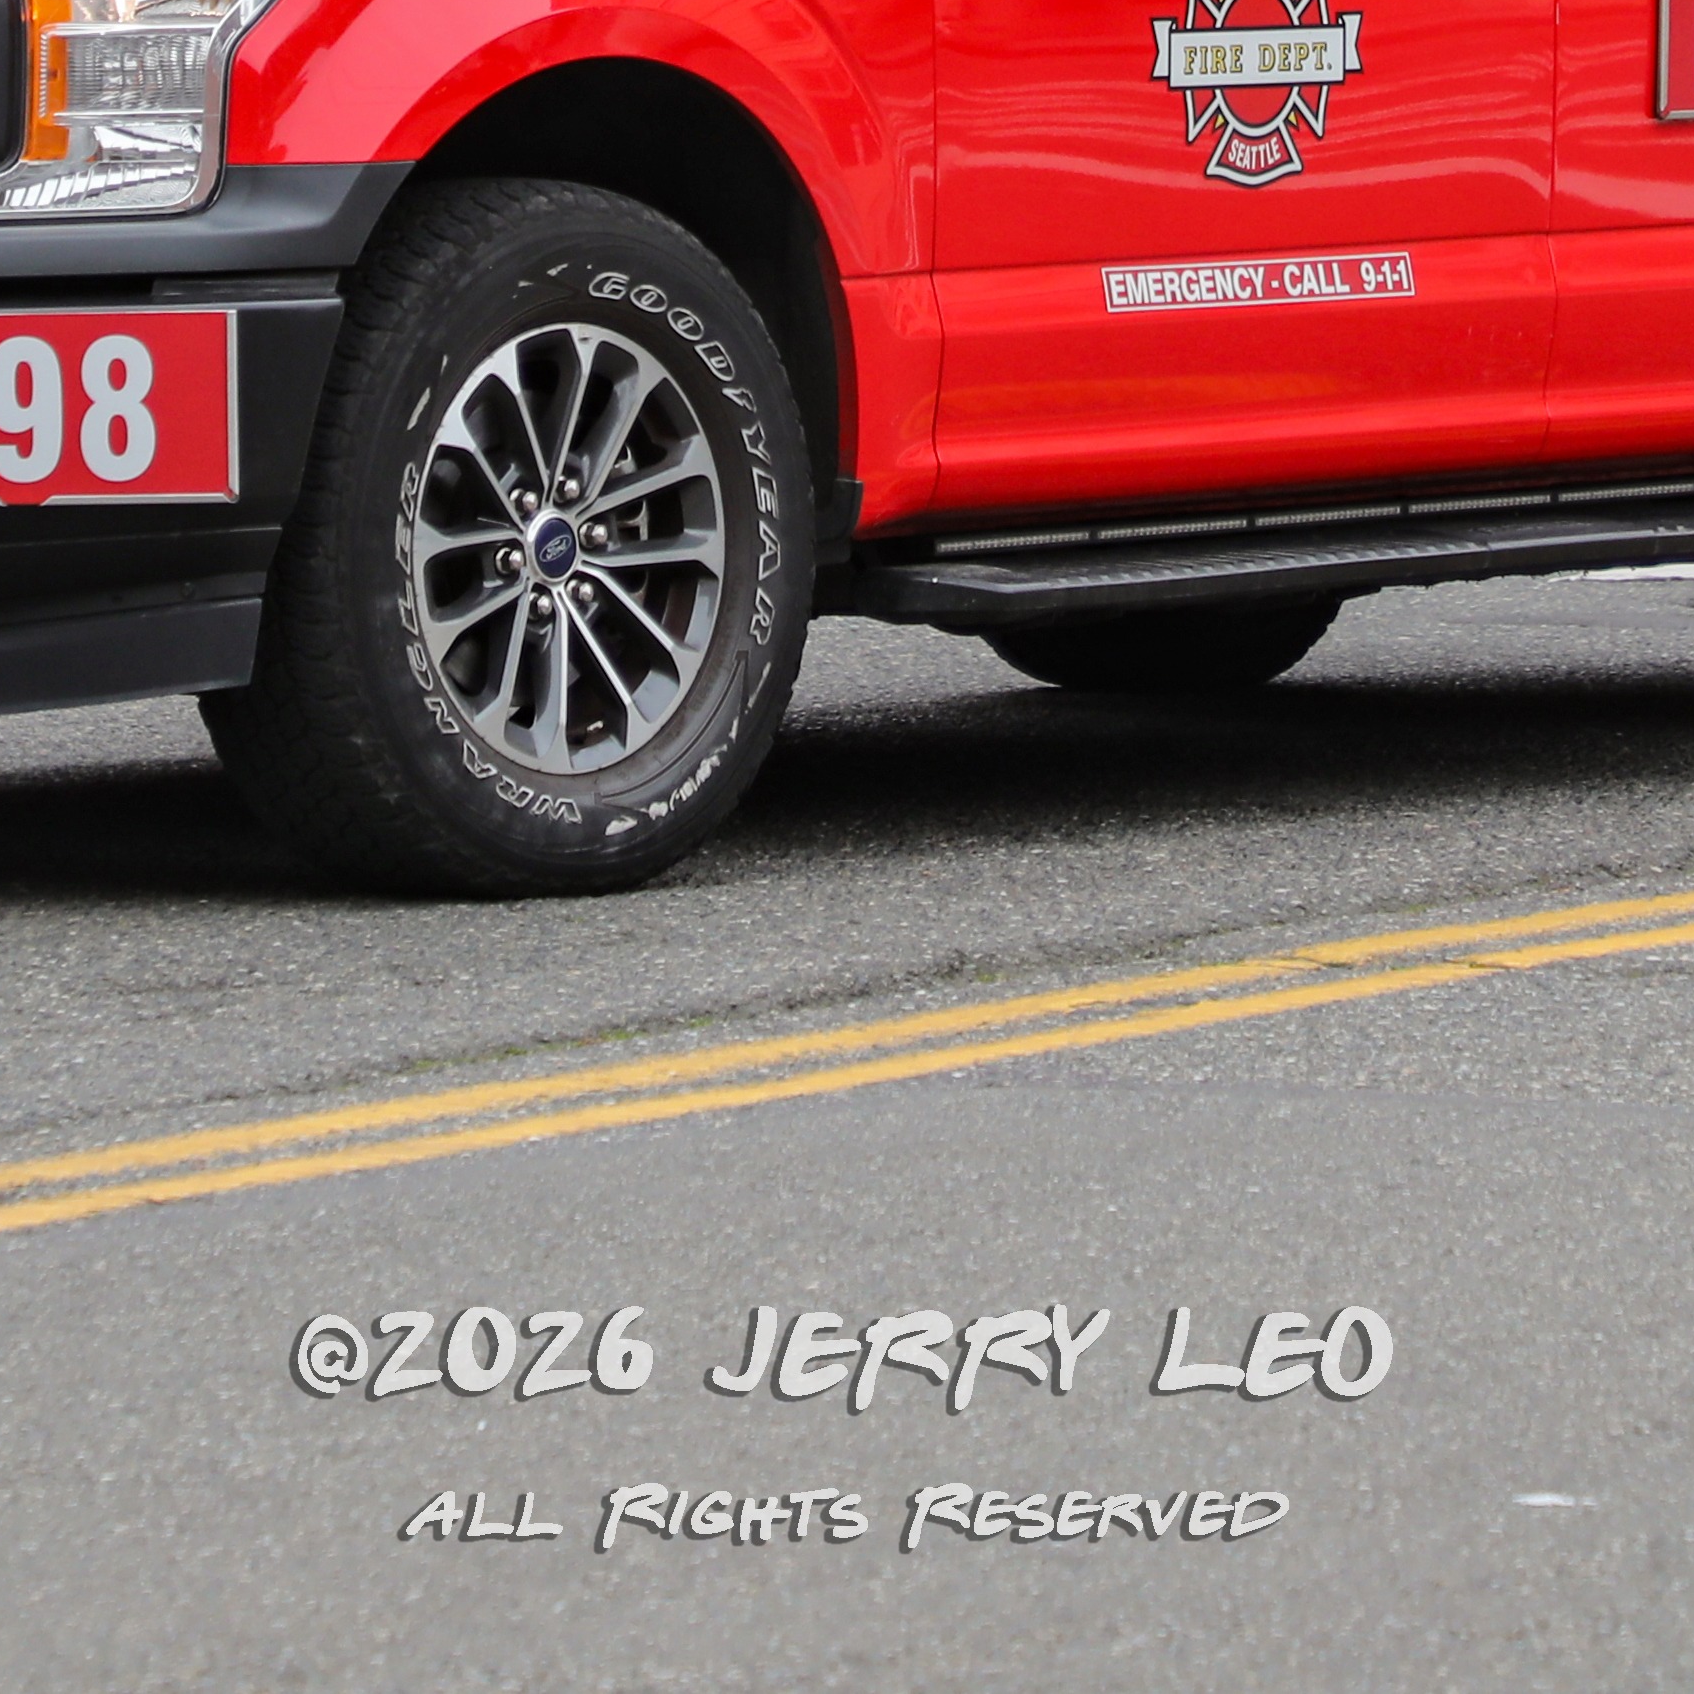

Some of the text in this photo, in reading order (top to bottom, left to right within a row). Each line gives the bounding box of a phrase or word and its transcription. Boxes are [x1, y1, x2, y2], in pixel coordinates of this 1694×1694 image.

[1183, 42, 1333, 74] FIRE DEPT.
[1227, 136, 1282, 170] SEATTLE
[1108, 266, 1265, 306] EMERGENCY
[1283, 262, 1351, 297] CALL
[1359, 259, 1410, 292] 9-1-1
[588, 270, 782, 646] GOODYEAR
[395, 462, 582, 825] WRANGLER
